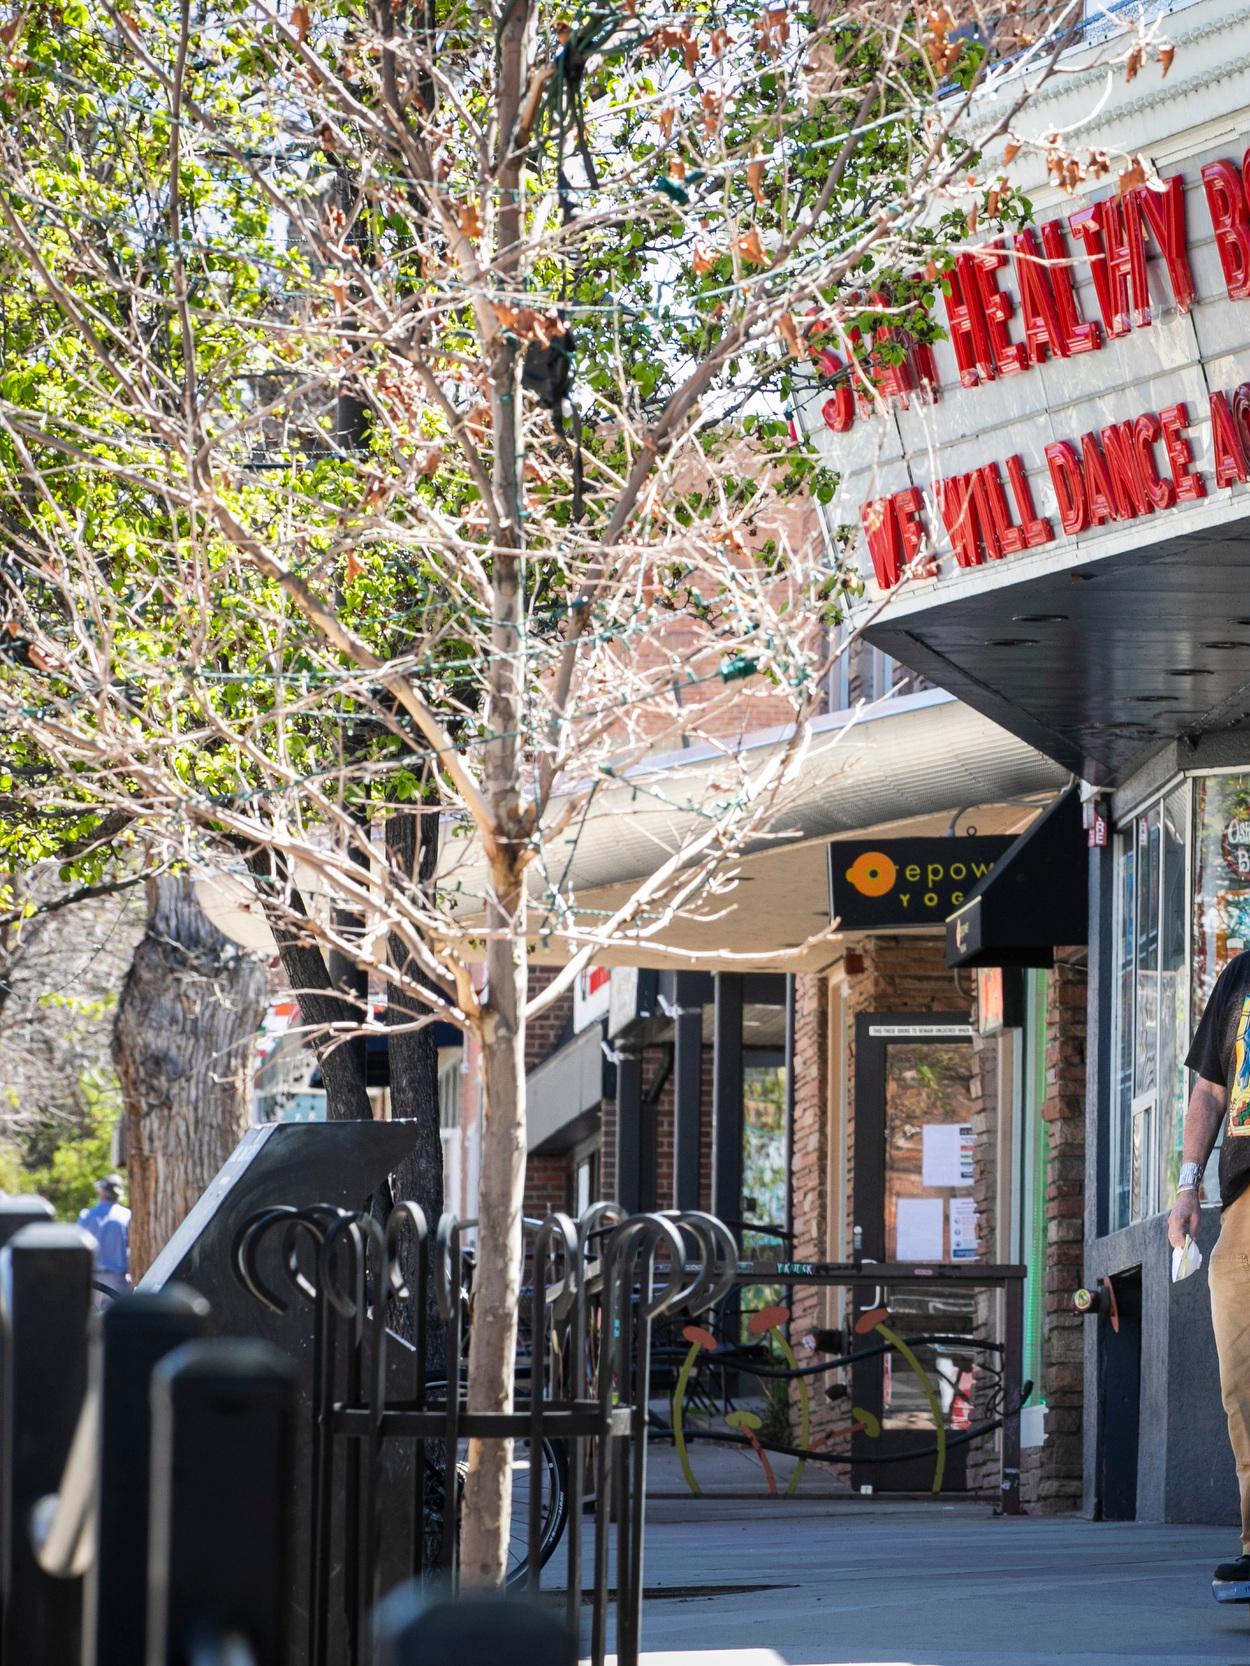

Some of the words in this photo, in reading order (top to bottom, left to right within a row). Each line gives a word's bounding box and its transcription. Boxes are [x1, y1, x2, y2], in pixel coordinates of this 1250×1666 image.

[941, 174, 1195, 389] HEALTHY
[859, 486, 939, 590] WE
[930, 453, 1054, 568] WILL
[1044, 402, 1206, 536] DANCE
